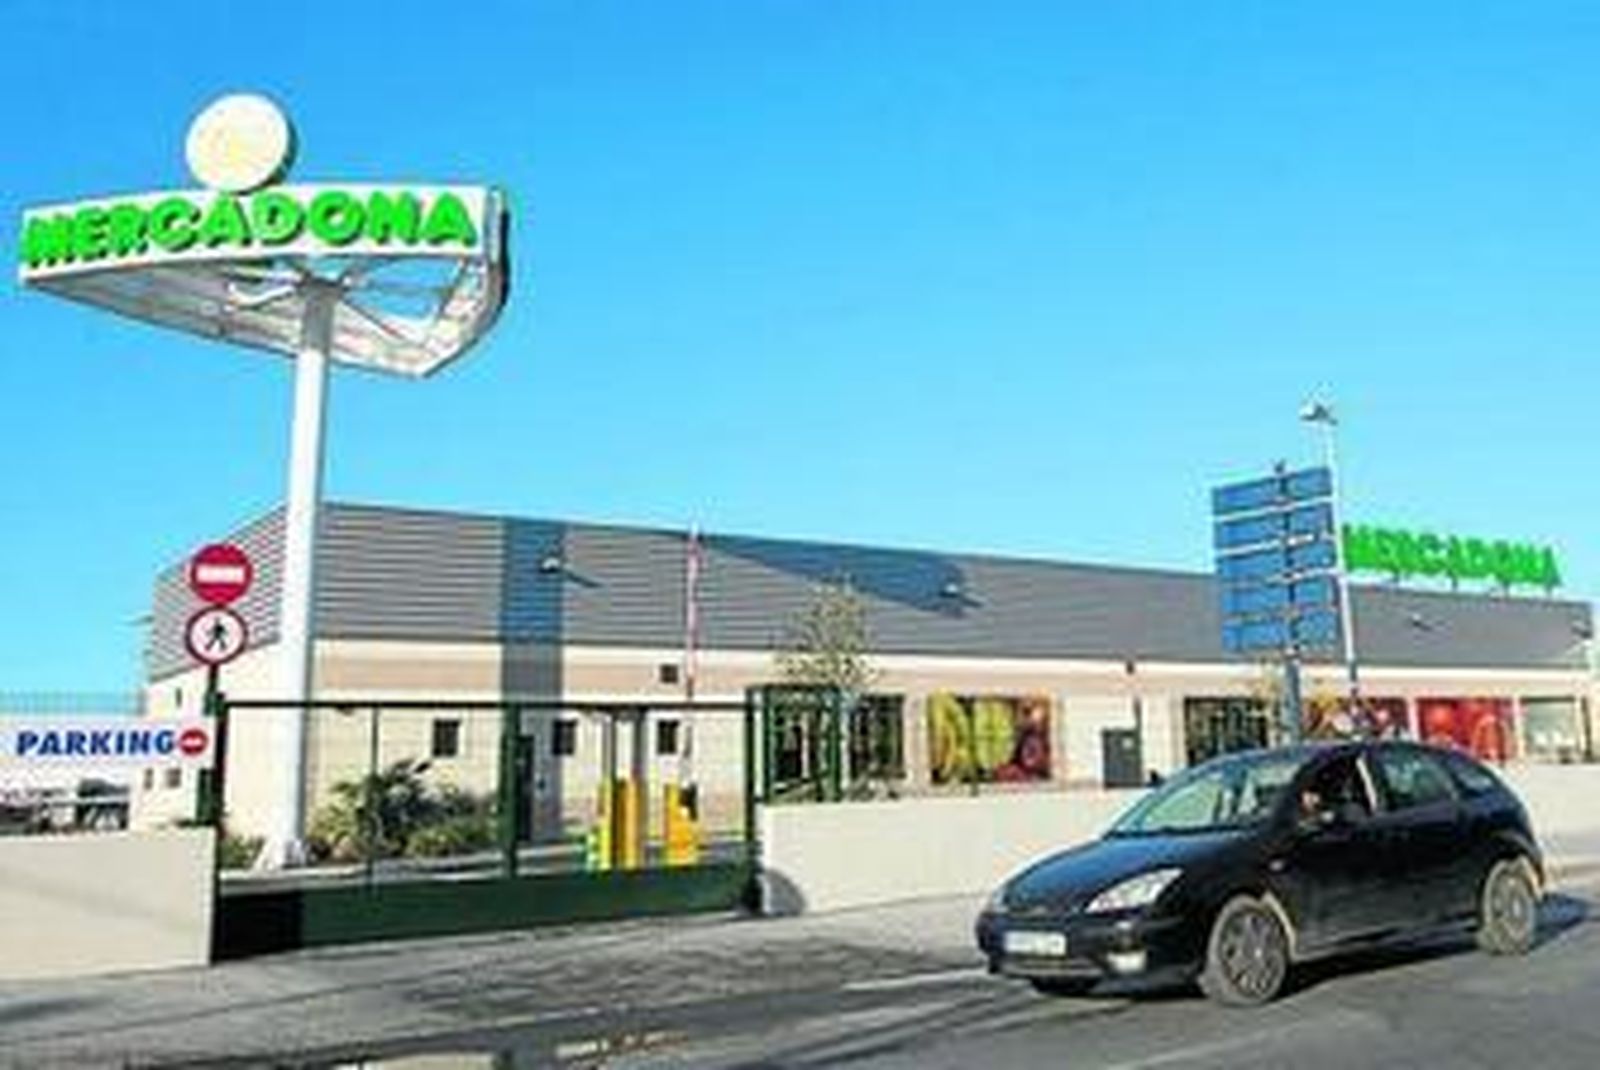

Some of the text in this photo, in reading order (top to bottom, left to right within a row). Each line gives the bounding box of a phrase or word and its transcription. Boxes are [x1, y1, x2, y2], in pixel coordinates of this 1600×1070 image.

[19, 190, 478, 267] MERCADONA
[1342, 523, 1562, 587] MERCADONA
[16, 729, 175, 756] PARKING
